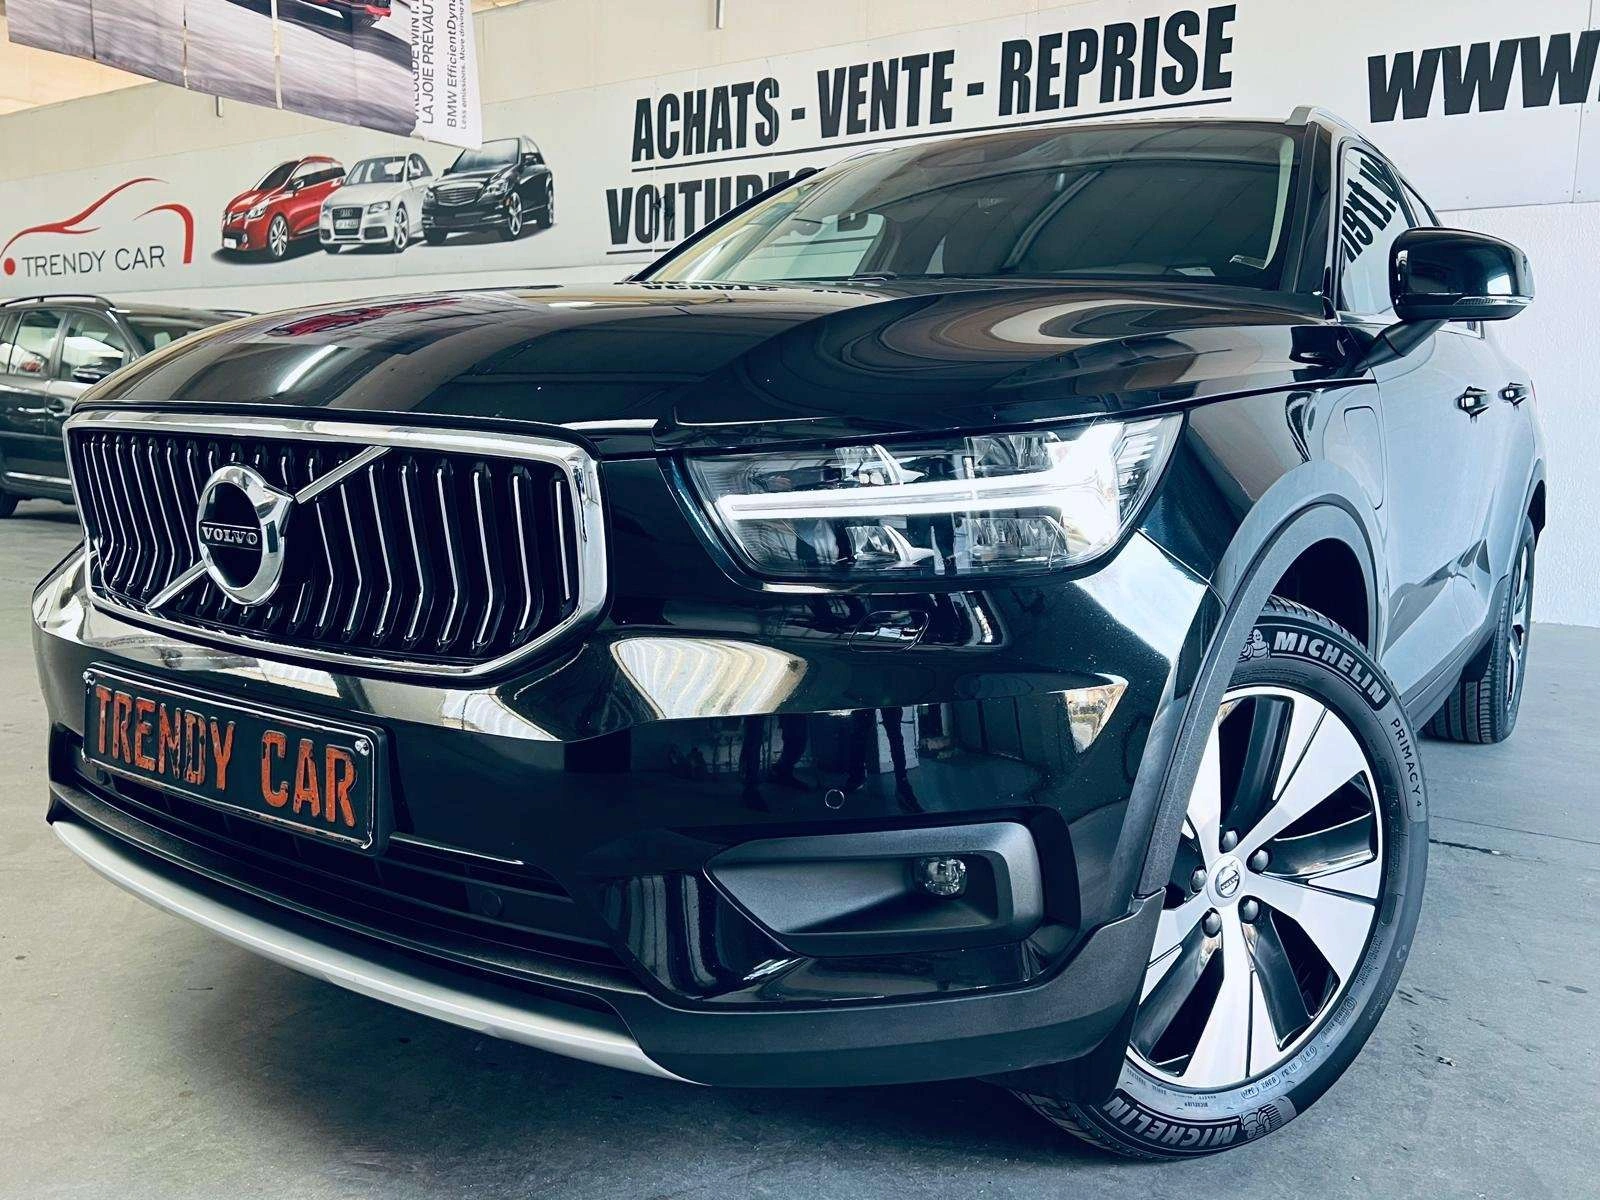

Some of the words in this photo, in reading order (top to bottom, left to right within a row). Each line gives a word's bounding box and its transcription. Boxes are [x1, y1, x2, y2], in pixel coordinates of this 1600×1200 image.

[422, 67, 434, 102] JOIE
[631, 77, 780, 162] ACHATS
[817, 49, 955, 139] VENTE
[998, 4, 1236, 117] REPRISE
[422, 104, 434, 124] LA
[447, 91, 457, 128] BMW
[22, 250, 106, 278] TRENDY
[115, 245, 166, 271] CAR
[201, 526, 258, 545] VOLVO
[1273, 631, 1387, 704] MICHELIN
[96, 684, 236, 791] TRENDY
[261, 729, 357, 828] CAR
[1390, 718, 1422, 795] PRIMACY
[1103, 1096, 1238, 1147] MICHELIN
